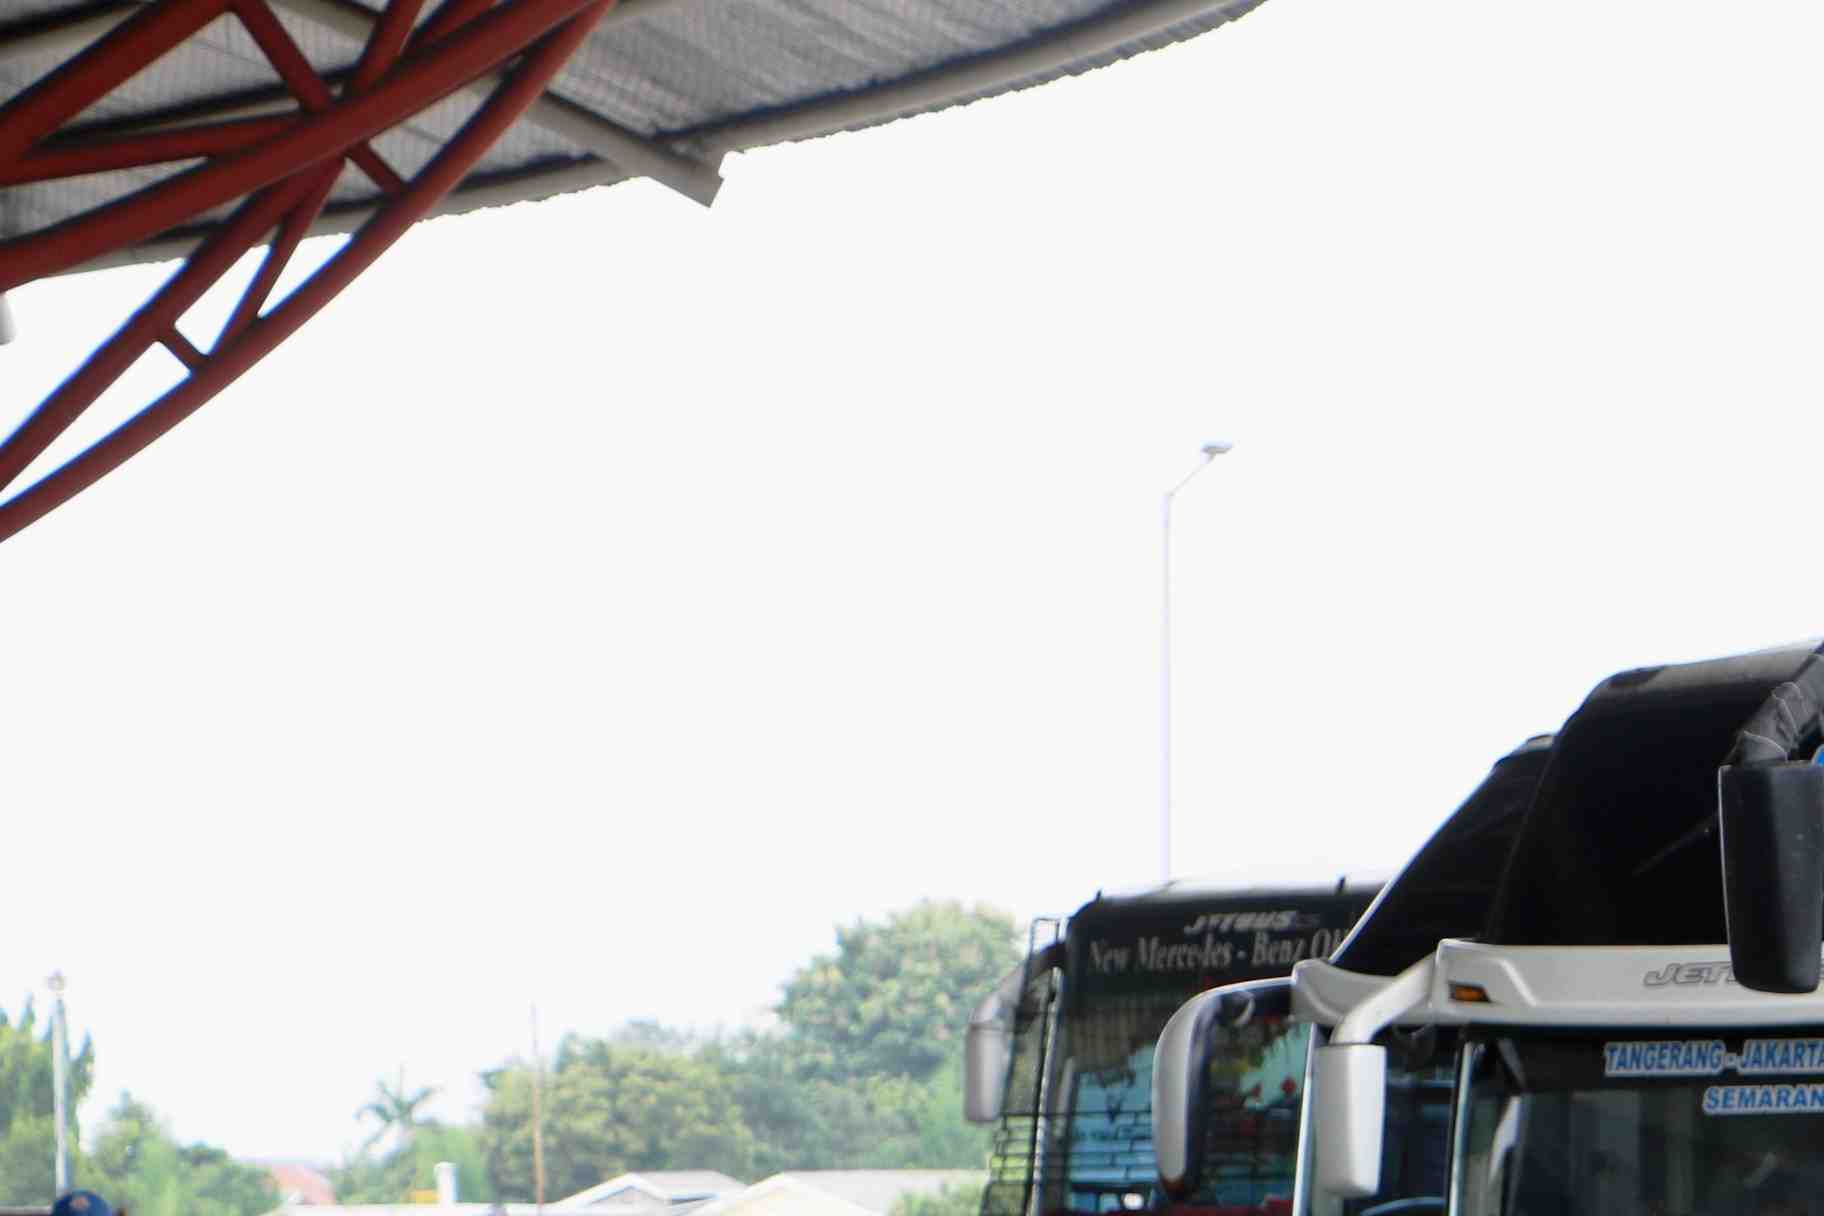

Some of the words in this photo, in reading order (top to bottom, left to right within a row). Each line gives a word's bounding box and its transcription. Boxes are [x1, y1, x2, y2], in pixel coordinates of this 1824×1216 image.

[1089, 940, 1131, 974] New
[1136, 936, 1232, 971] Mercedes
[1605, 1043, 1726, 1073] TANGERANG
